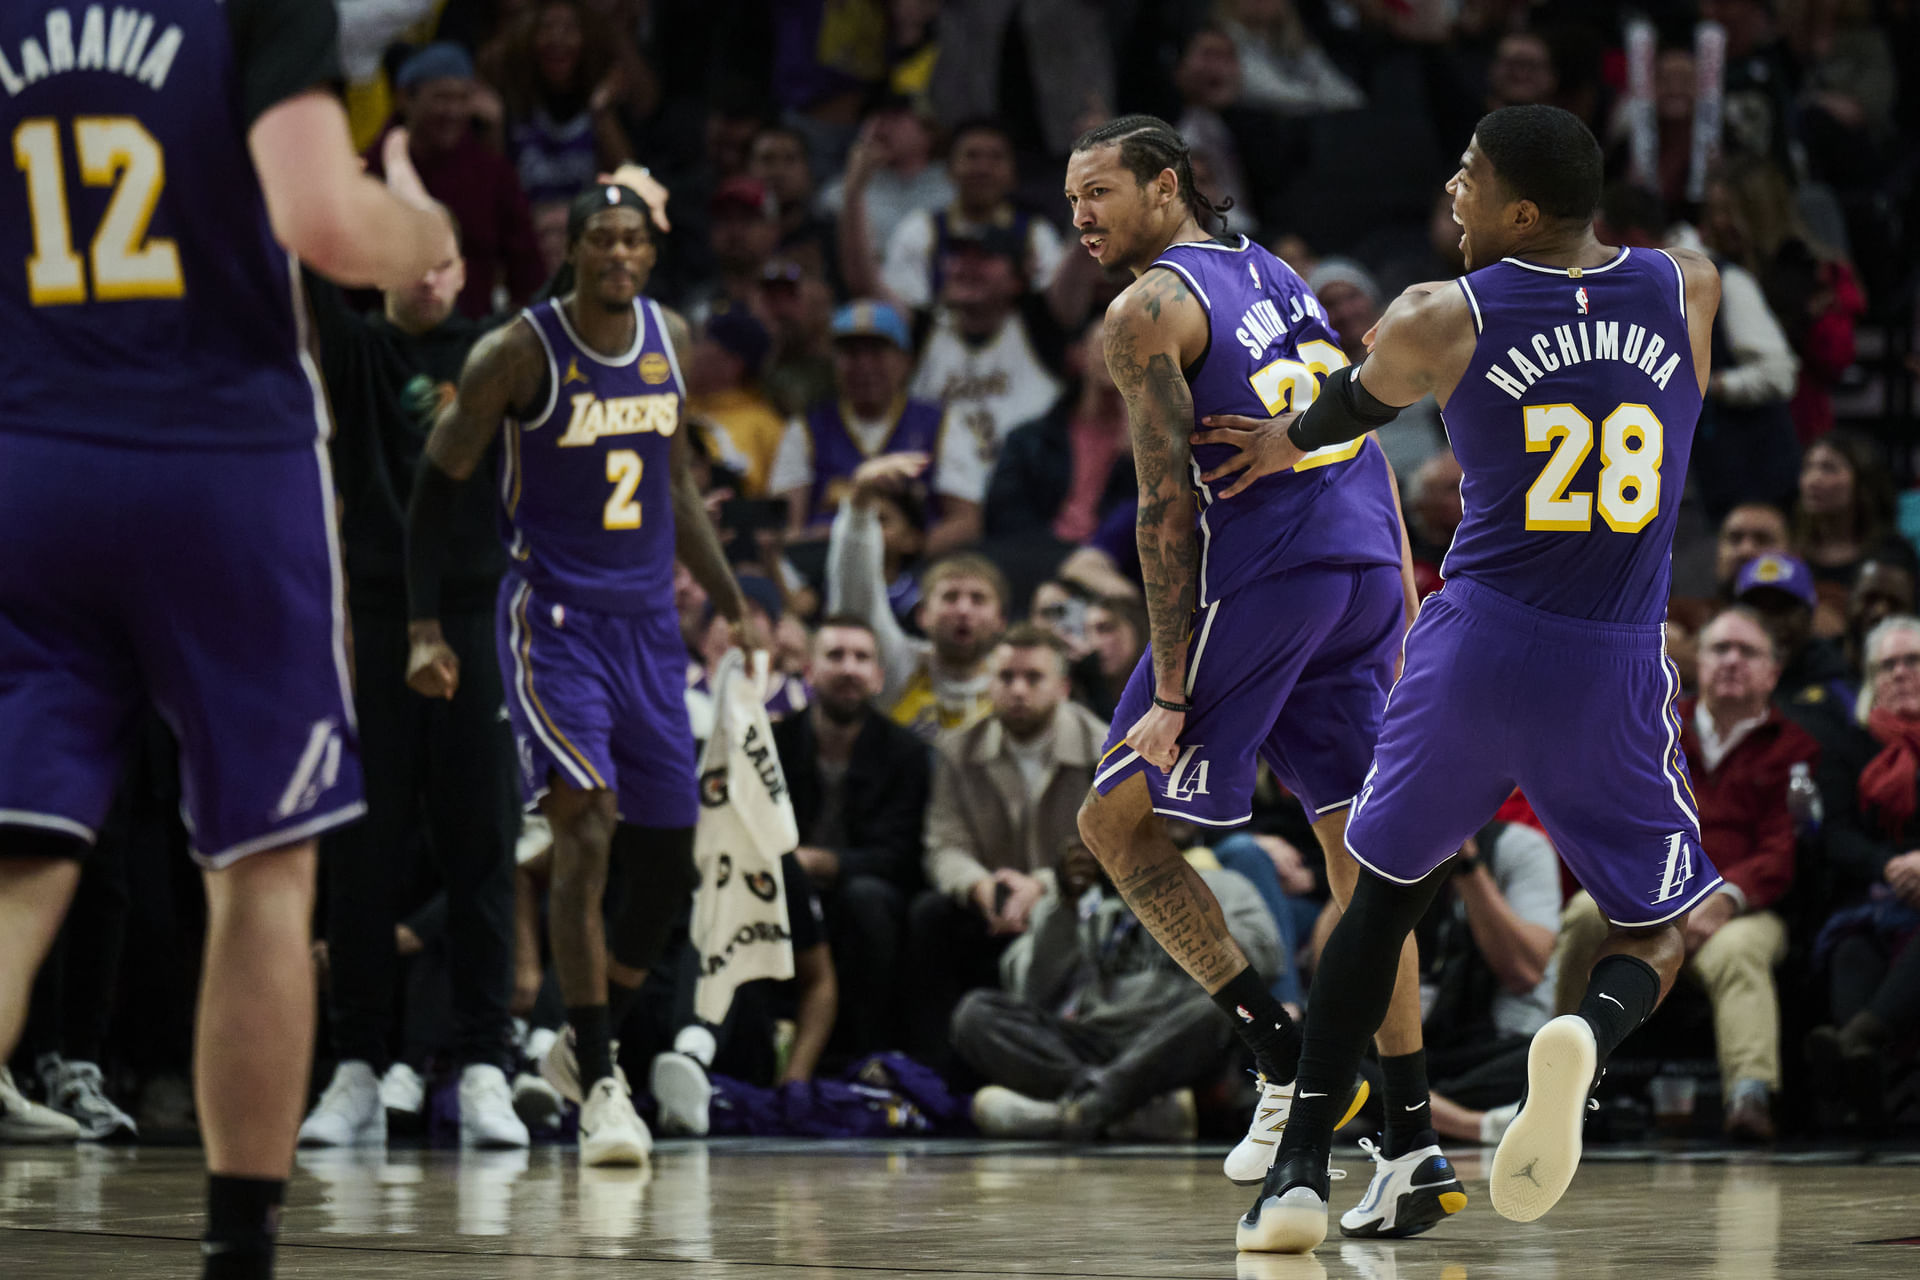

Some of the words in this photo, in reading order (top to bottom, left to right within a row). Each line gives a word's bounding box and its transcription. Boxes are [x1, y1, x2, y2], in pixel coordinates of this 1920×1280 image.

[12, 114, 187, 307] 12
[1235, 298, 1289, 360] SMITH
[1485, 320, 1681, 400] HACHIMURA
[556, 392, 680, 447] LAKERS
[603, 448, 644, 531] 2
[1523, 402, 1664, 534] 28
[1648, 830, 1695, 905] LA
